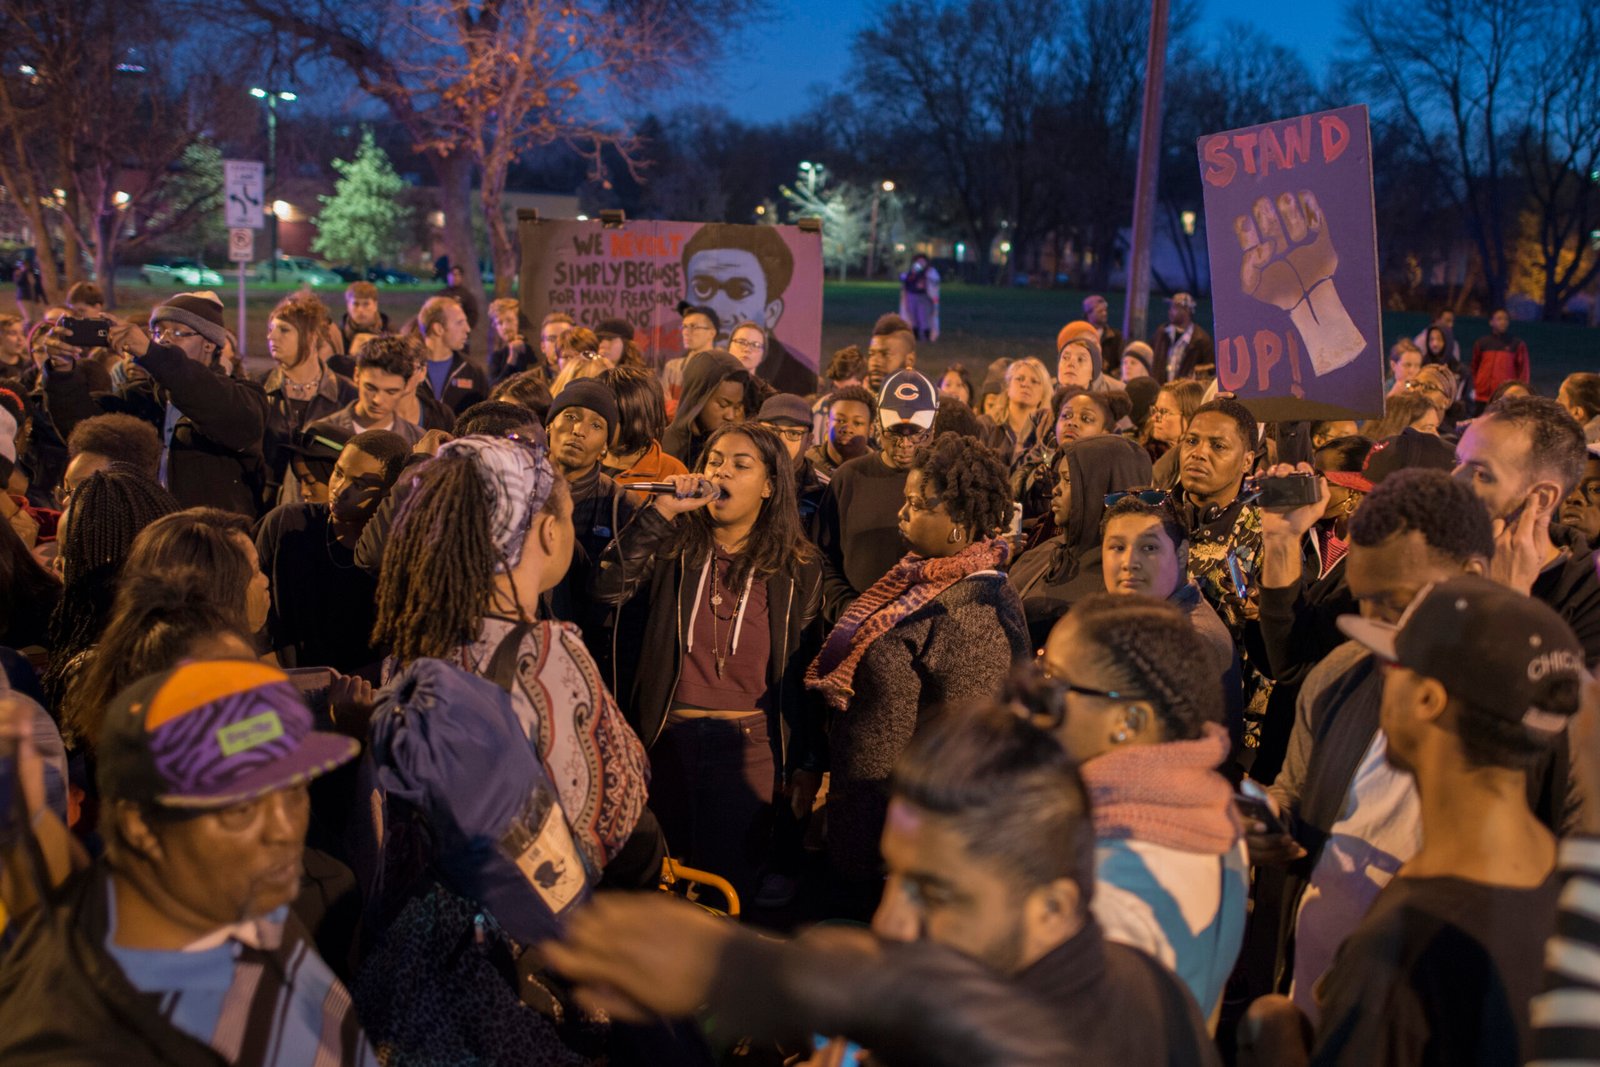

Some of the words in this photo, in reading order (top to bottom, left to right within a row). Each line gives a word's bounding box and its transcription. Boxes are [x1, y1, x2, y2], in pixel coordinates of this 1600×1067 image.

[1204, 115, 1350, 188] STAND
[573, 233, 603, 256] WE
[611, 232, 684, 257] REVOLT
[554, 262, 622, 286] SIMPLY
[549, 288, 576, 305] FOR
[580, 287, 617, 306] MANY
[620, 289, 682, 311] REASONS
[1218, 329, 1305, 400] UP!
[894, 383, 919, 400] C
